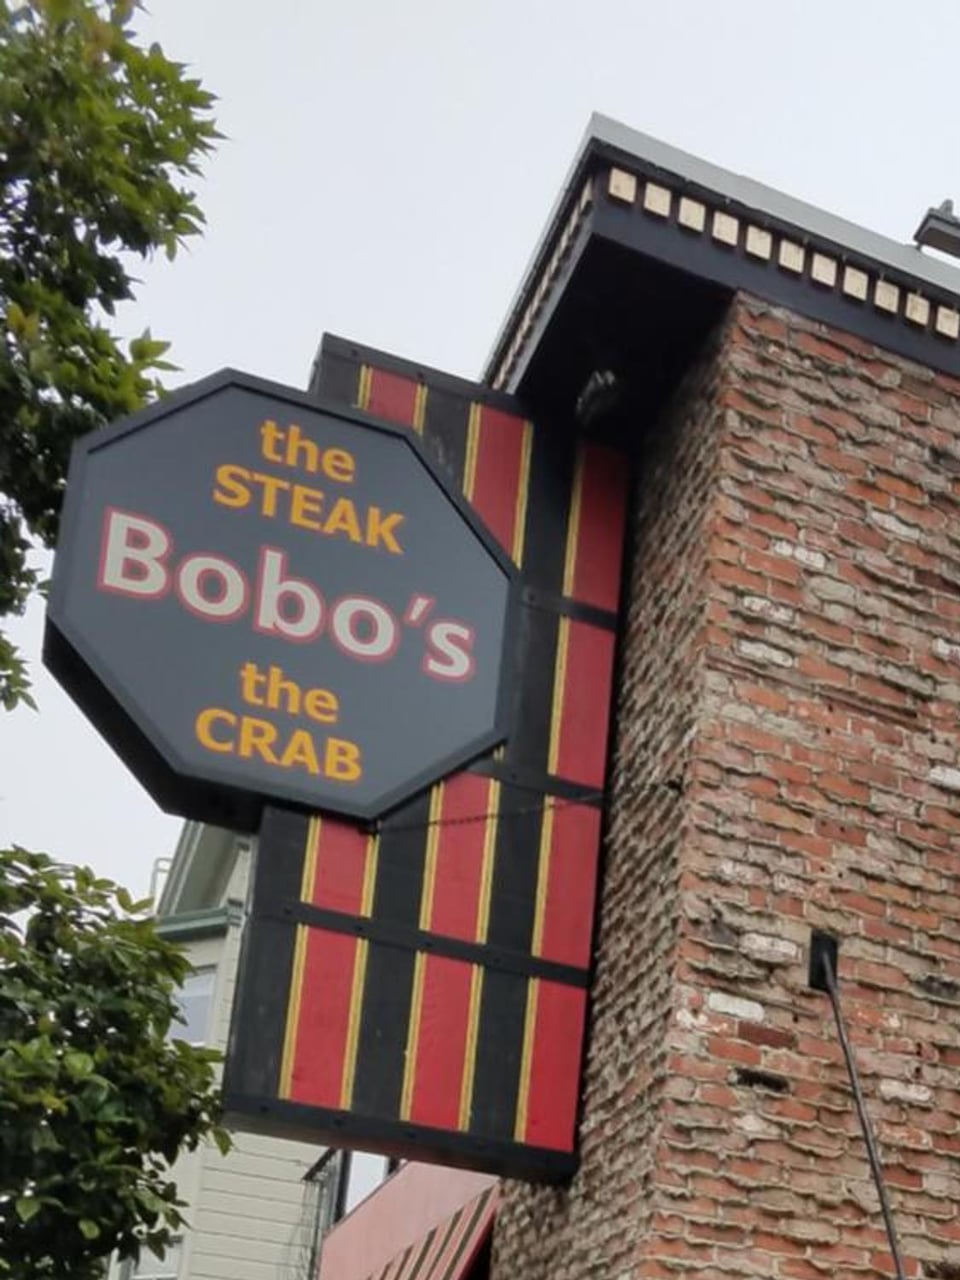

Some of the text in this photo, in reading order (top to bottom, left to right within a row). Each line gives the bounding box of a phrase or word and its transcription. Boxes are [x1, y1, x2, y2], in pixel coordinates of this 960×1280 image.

[260, 419, 355, 482] the
[213, 464, 404, 555] STEAK
[98, 506, 475, 682] Bobo's
[240, 661, 340, 723] the
[195, 708, 362, 783] CRAB
